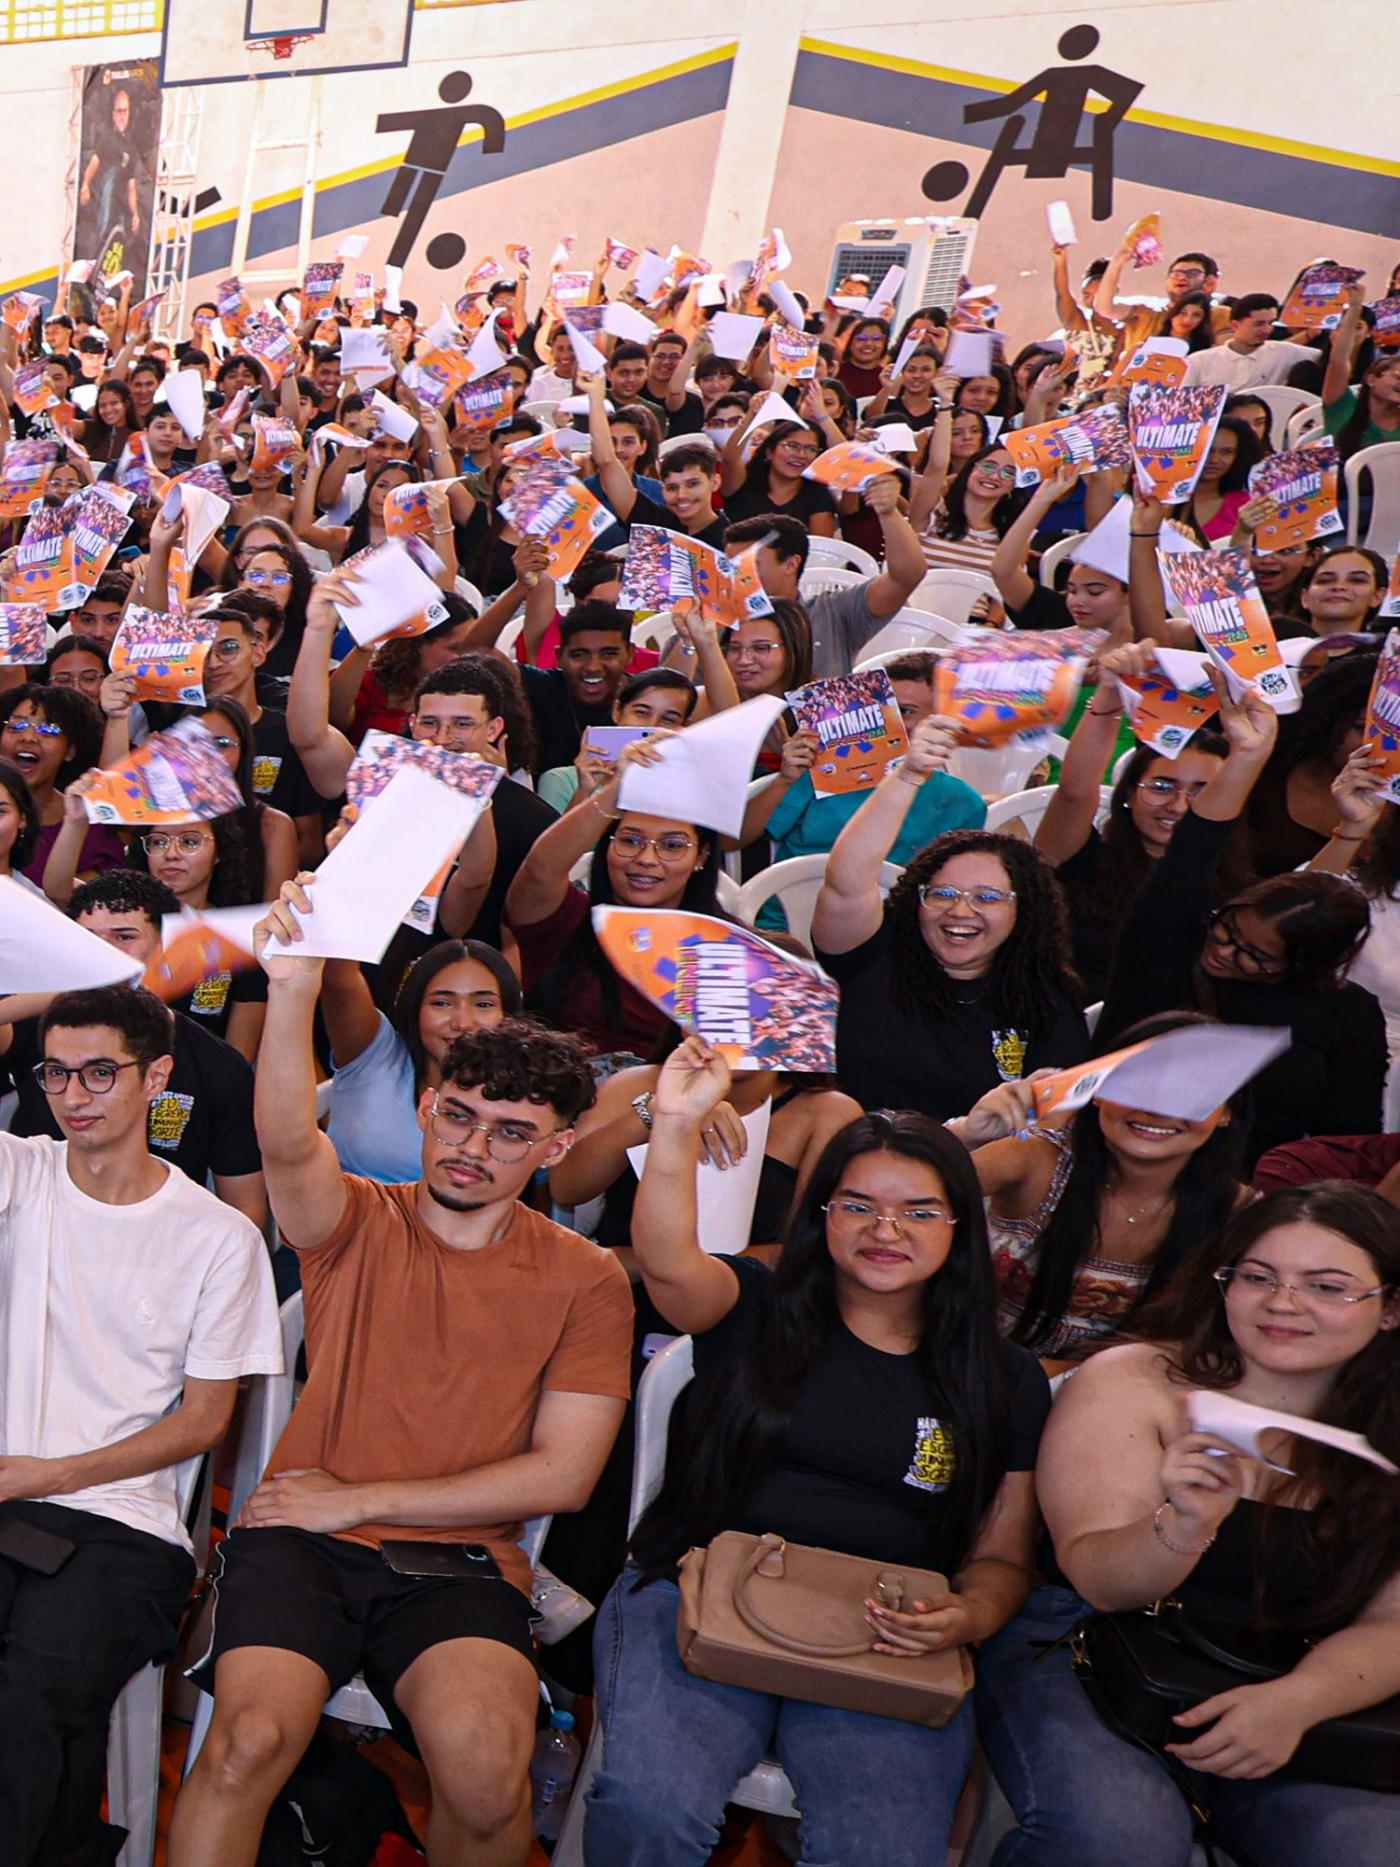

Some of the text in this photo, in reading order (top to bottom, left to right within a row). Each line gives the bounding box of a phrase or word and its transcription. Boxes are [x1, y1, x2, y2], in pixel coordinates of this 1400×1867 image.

[1137, 422, 1200, 448] ULTIMATE
[670, 545, 694, 597] ULTIMATE
[1183, 597, 1245, 637] TIMATE
[129, 643, 192, 661] ULTIMATE
[817, 703, 884, 743] ULTIMATE
[698, 943, 750, 1045] ULTIMATE
